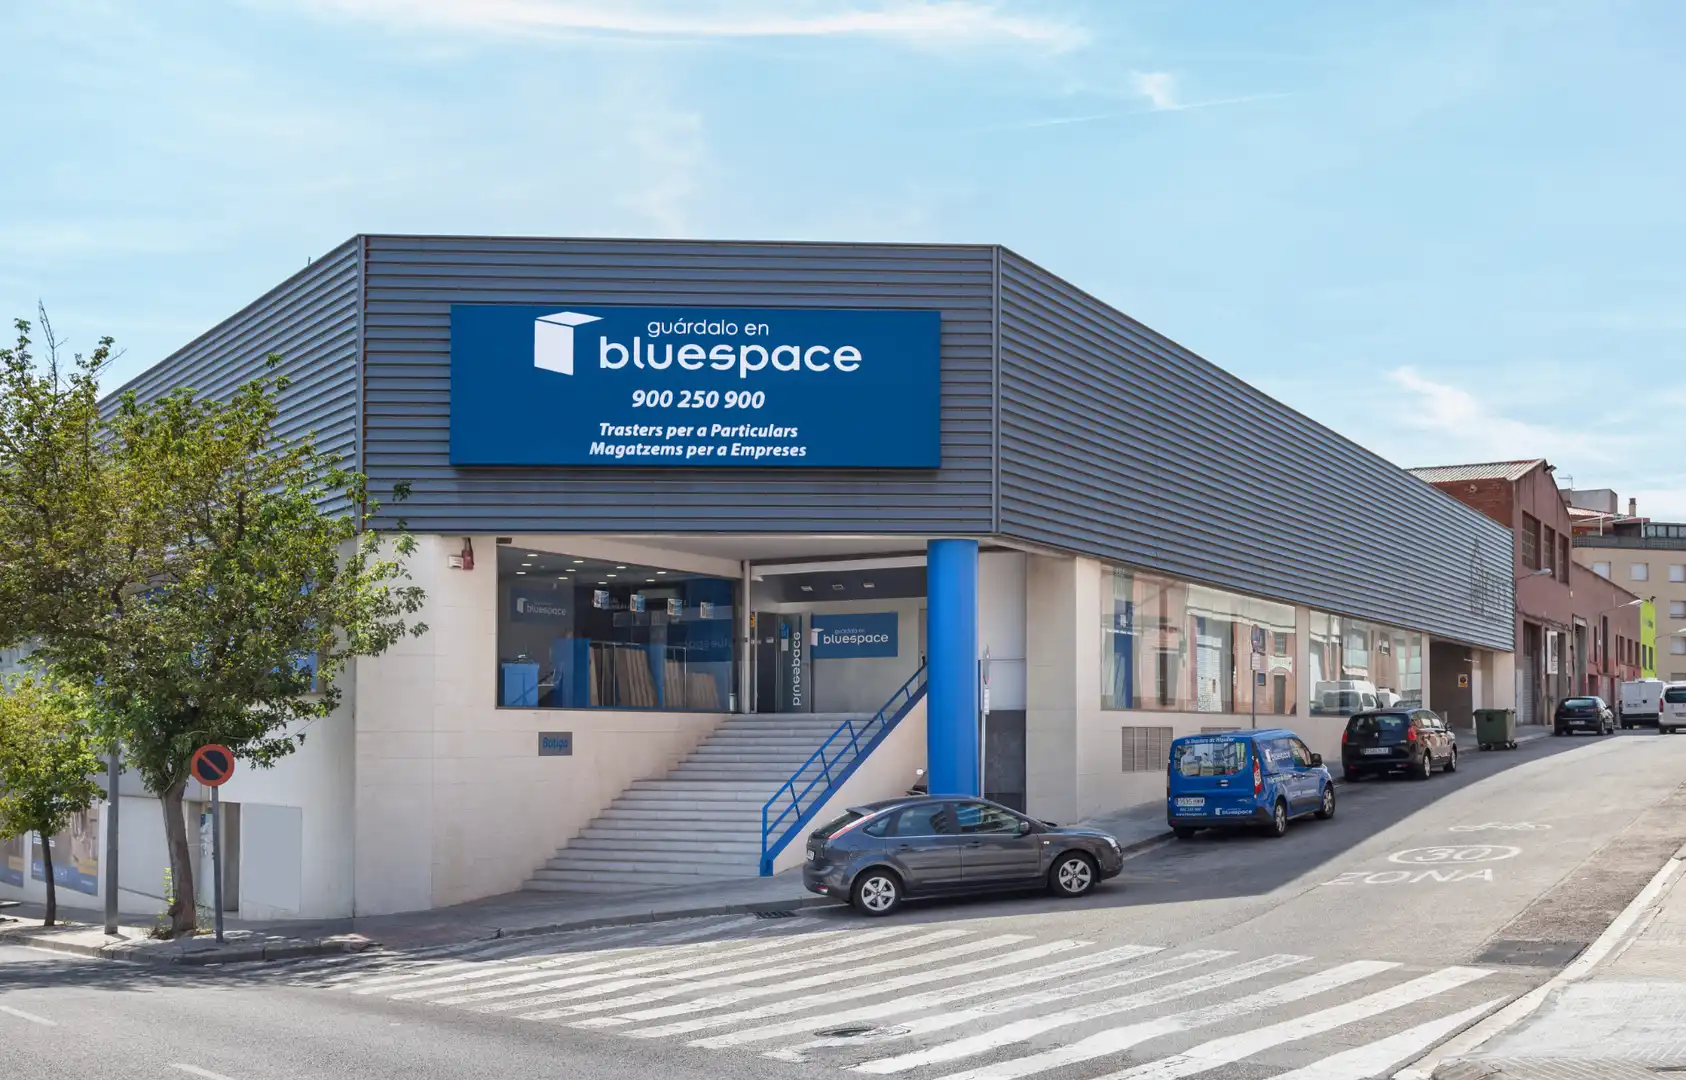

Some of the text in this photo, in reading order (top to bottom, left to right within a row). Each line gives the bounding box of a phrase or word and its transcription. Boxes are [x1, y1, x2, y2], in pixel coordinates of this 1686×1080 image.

[647, 317, 770, 338] guárdalo en
[599, 335, 863, 379] bluespace
[632, 389, 766, 409] 900 250 900
[599, 422, 799, 440] Trasters per a Particulars
[589, 441, 807, 460] Magatzems per a Empreses
[823, 632, 889, 646] bluespace
[1415, 848, 1493, 862] 30
[1321, 868, 1494, 886] ZONA
